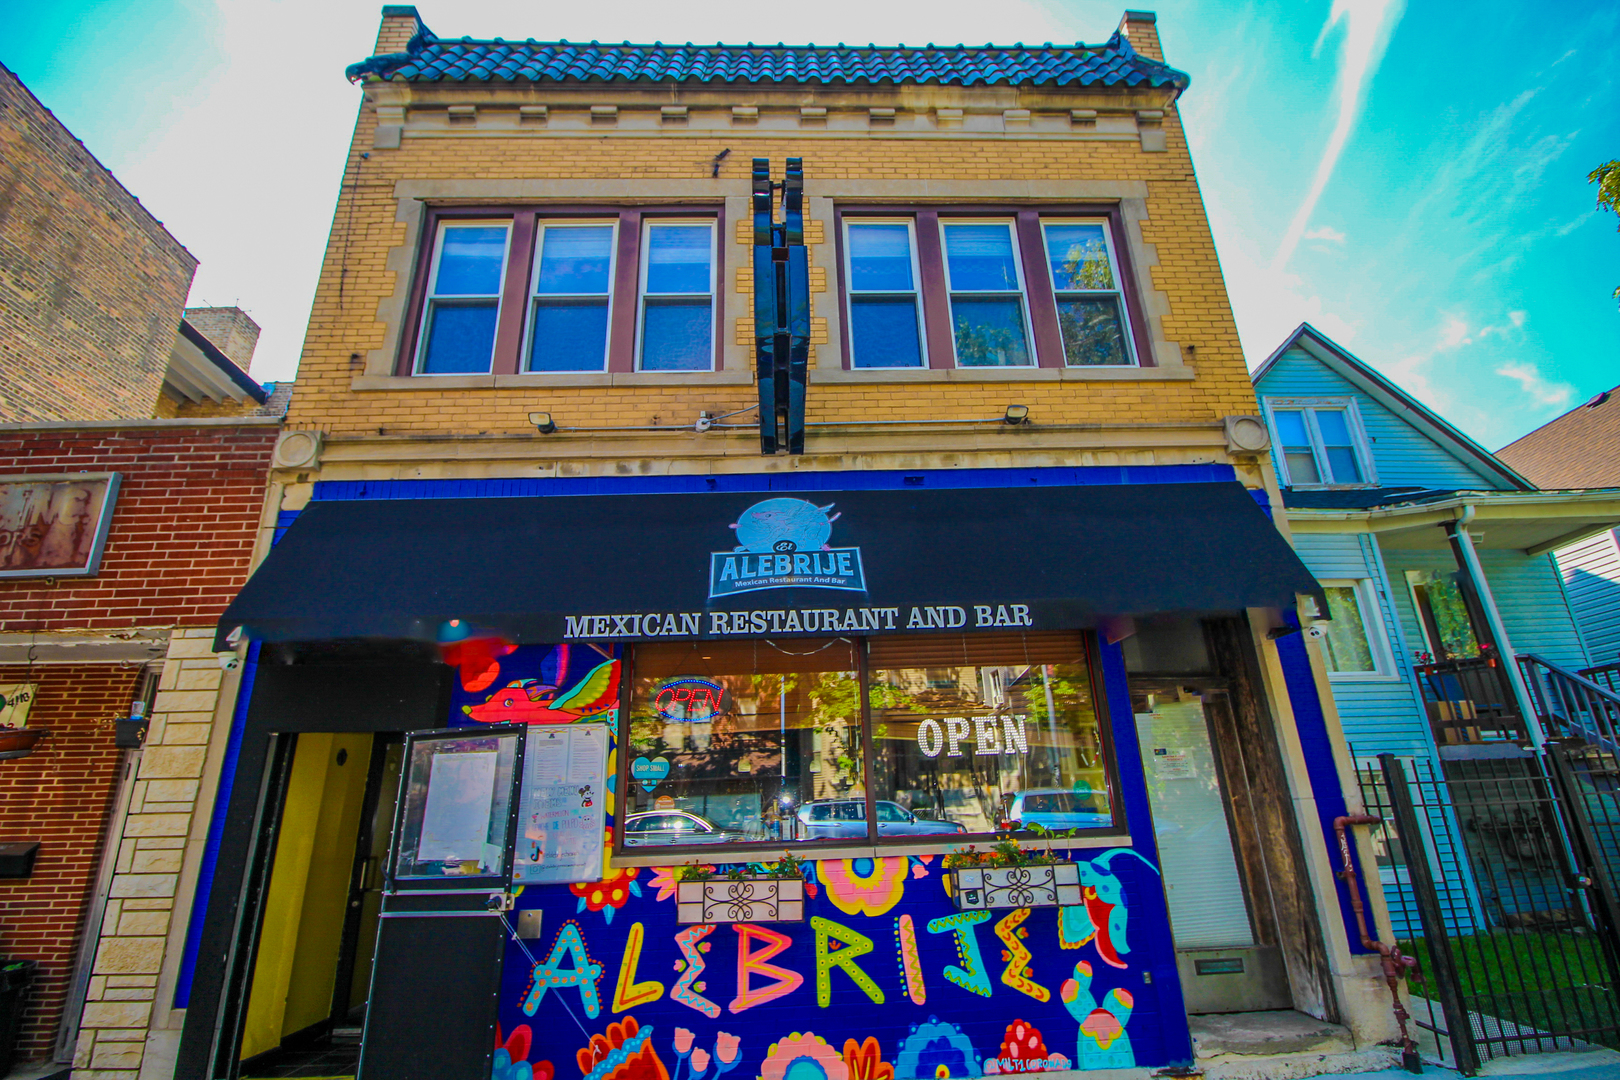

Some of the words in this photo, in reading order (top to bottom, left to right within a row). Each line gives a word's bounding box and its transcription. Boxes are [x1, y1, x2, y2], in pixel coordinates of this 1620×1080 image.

[775, 541, 793, 552] El
[720, 552, 854, 582] ALEBRIJE
[735, 578, 768, 588] Mexican
[831, 577, 846, 585] Bar
[564, 613, 701, 638] MEXICAN
[709, 607, 899, 634] RESTAURANT
[906, 606, 967, 629] AND
[973, 604, 1033, 628] BAR
[655, 688, 724, 712] OPEN
[918, 715, 1028, 758] OPEN
[650, 764, 665, 772] SMALL
[518, 908, 1051, 1019] ALEBRIJE
